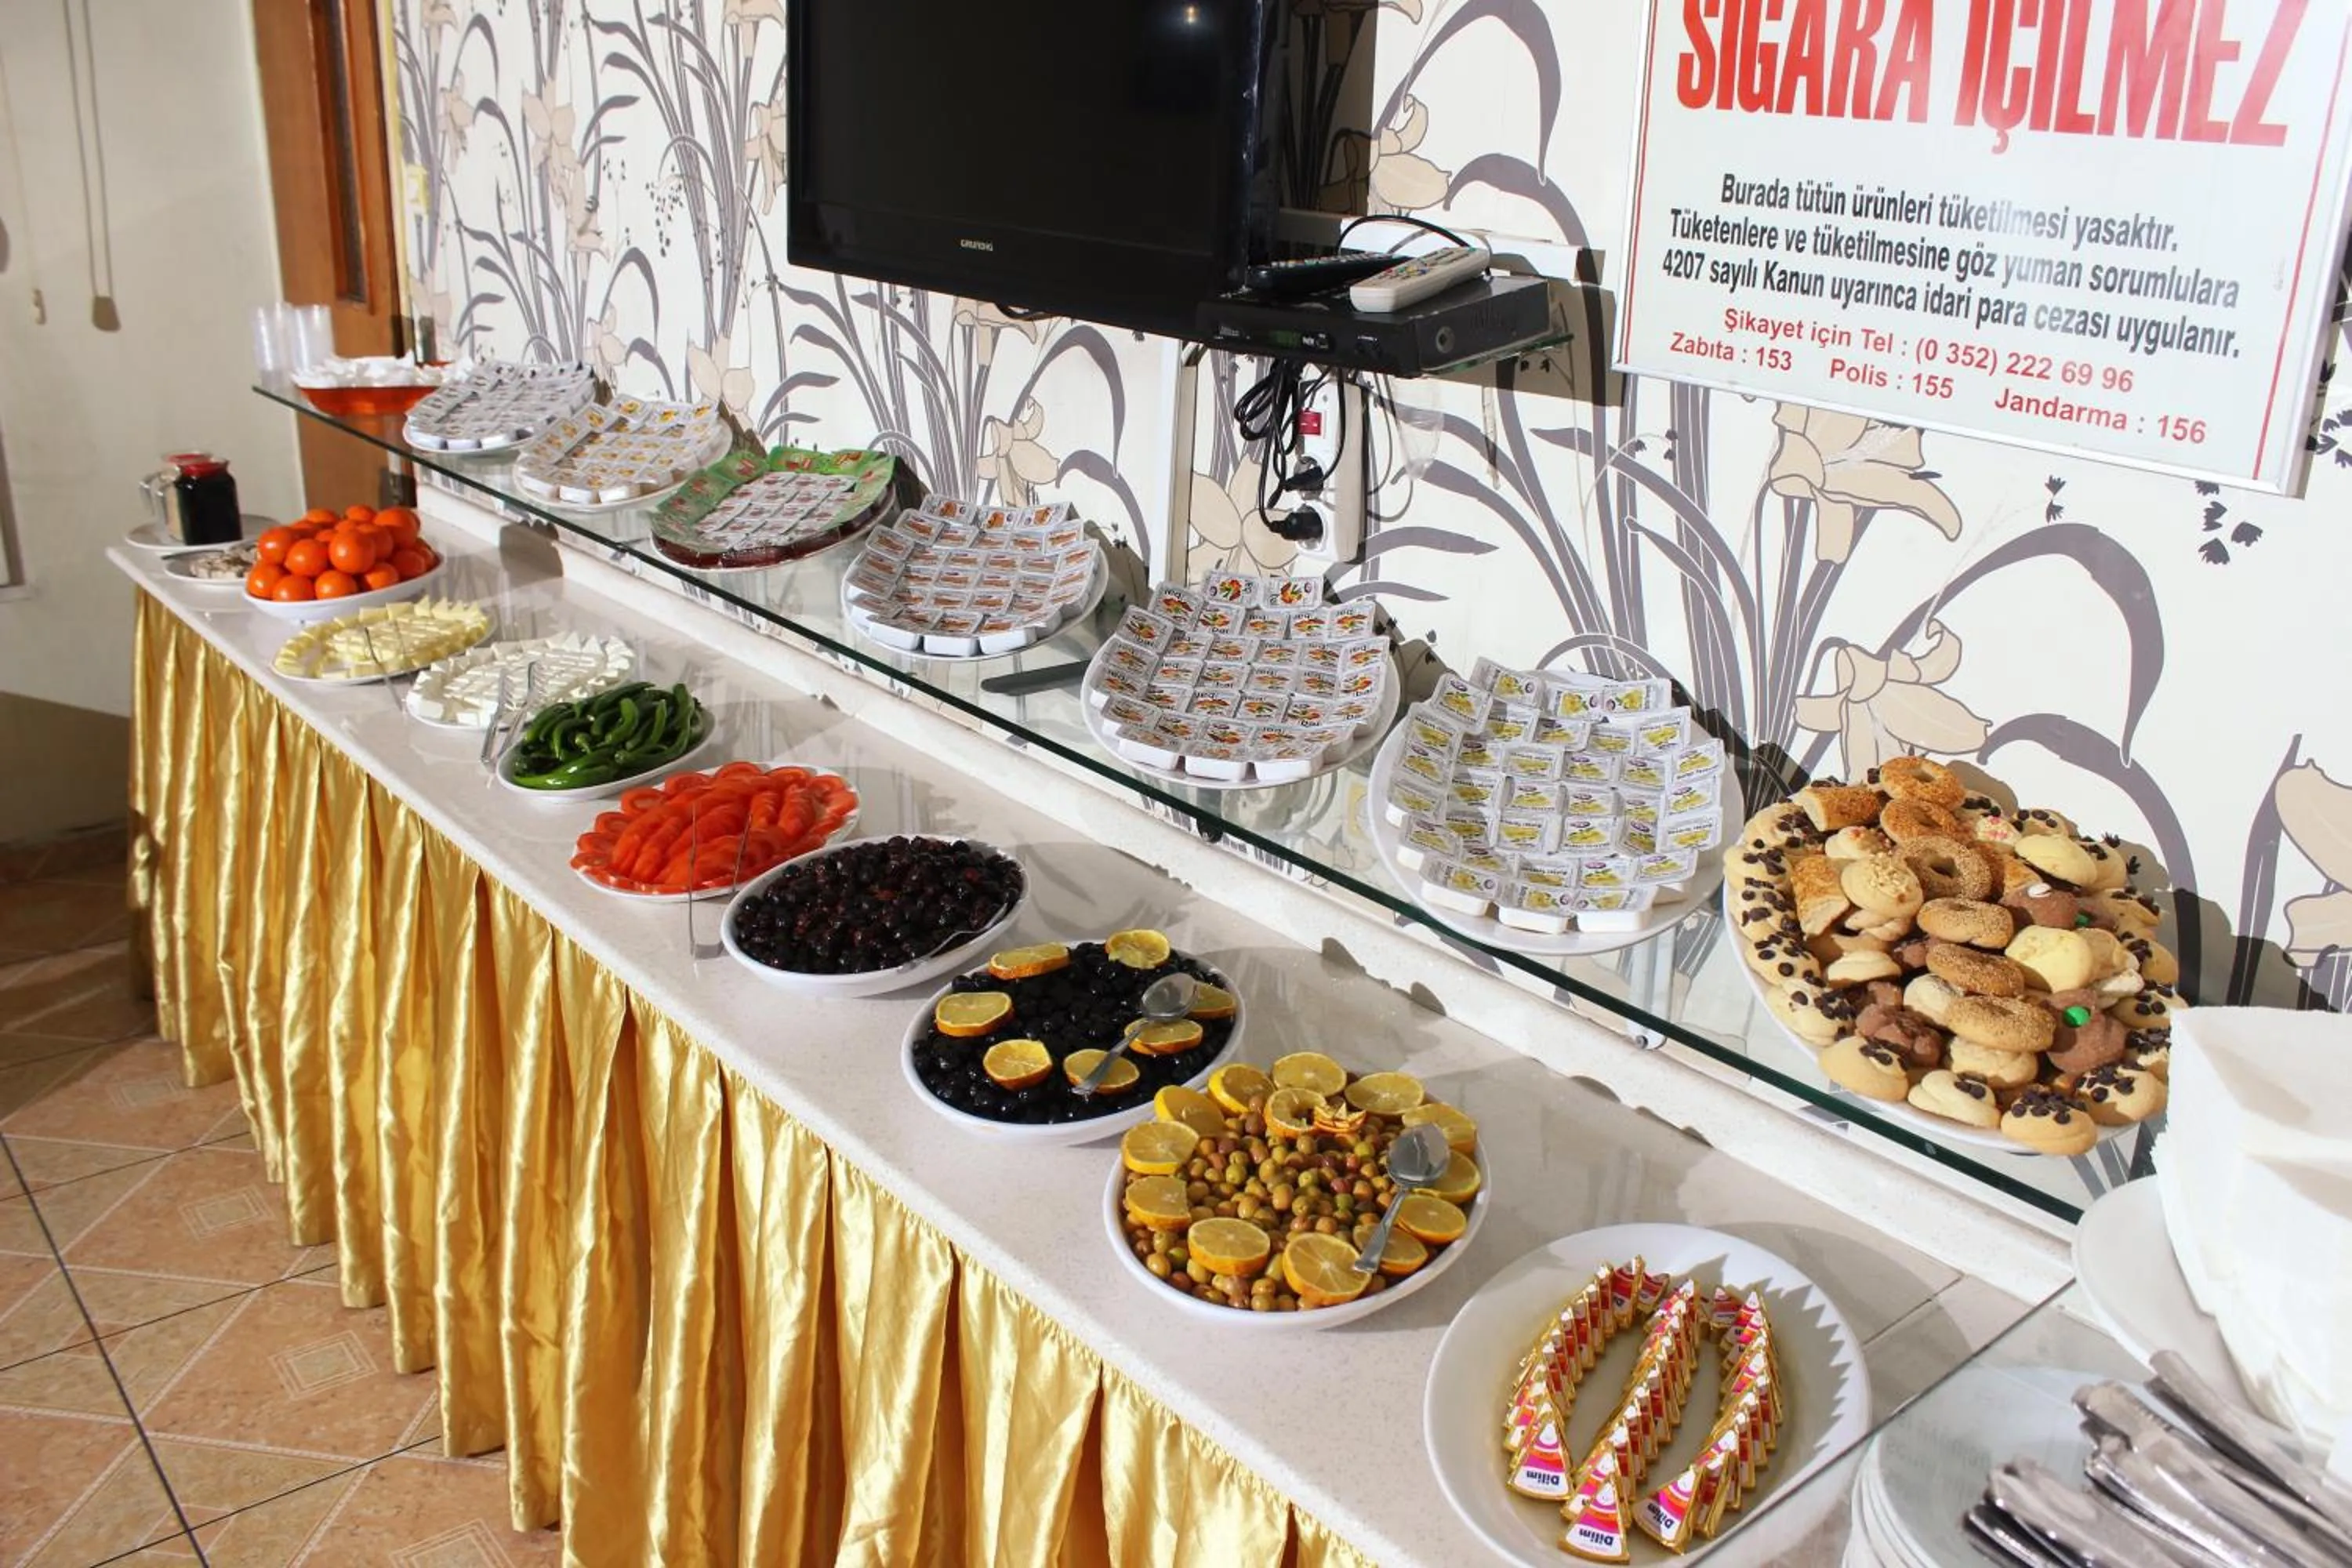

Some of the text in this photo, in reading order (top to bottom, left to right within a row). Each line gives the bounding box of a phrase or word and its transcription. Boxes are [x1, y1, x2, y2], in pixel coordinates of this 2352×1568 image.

[1721, 173, 2179, 252] Burada tütün ürünleri tüketilmesi yasaktır.
[1671, 208, 1778, 250] Tüketenlere
[1784, 228, 1806, 253] ve
[1813, 223, 1951, 272] tüketilmesine
[1956, 241, 1998, 282] göz
[2002, 253, 2083, 289] yuman
[2089, 264, 2241, 309] sorumlulara
[1662, 249, 2241, 359] 4207 sayılı Kanun uyarınca idari para cezası uygulanır.
[1670, 332, 2207, 445] Zabıta : 153 Polis : 155 Jandarma : 156
[1724, 308, 2134, 393] Şikayet için Tel : (0 352) 222 69 96
[1526, 1469, 1561, 1486] Dilim
[1578, 1527, 1615, 1547] Dilim
